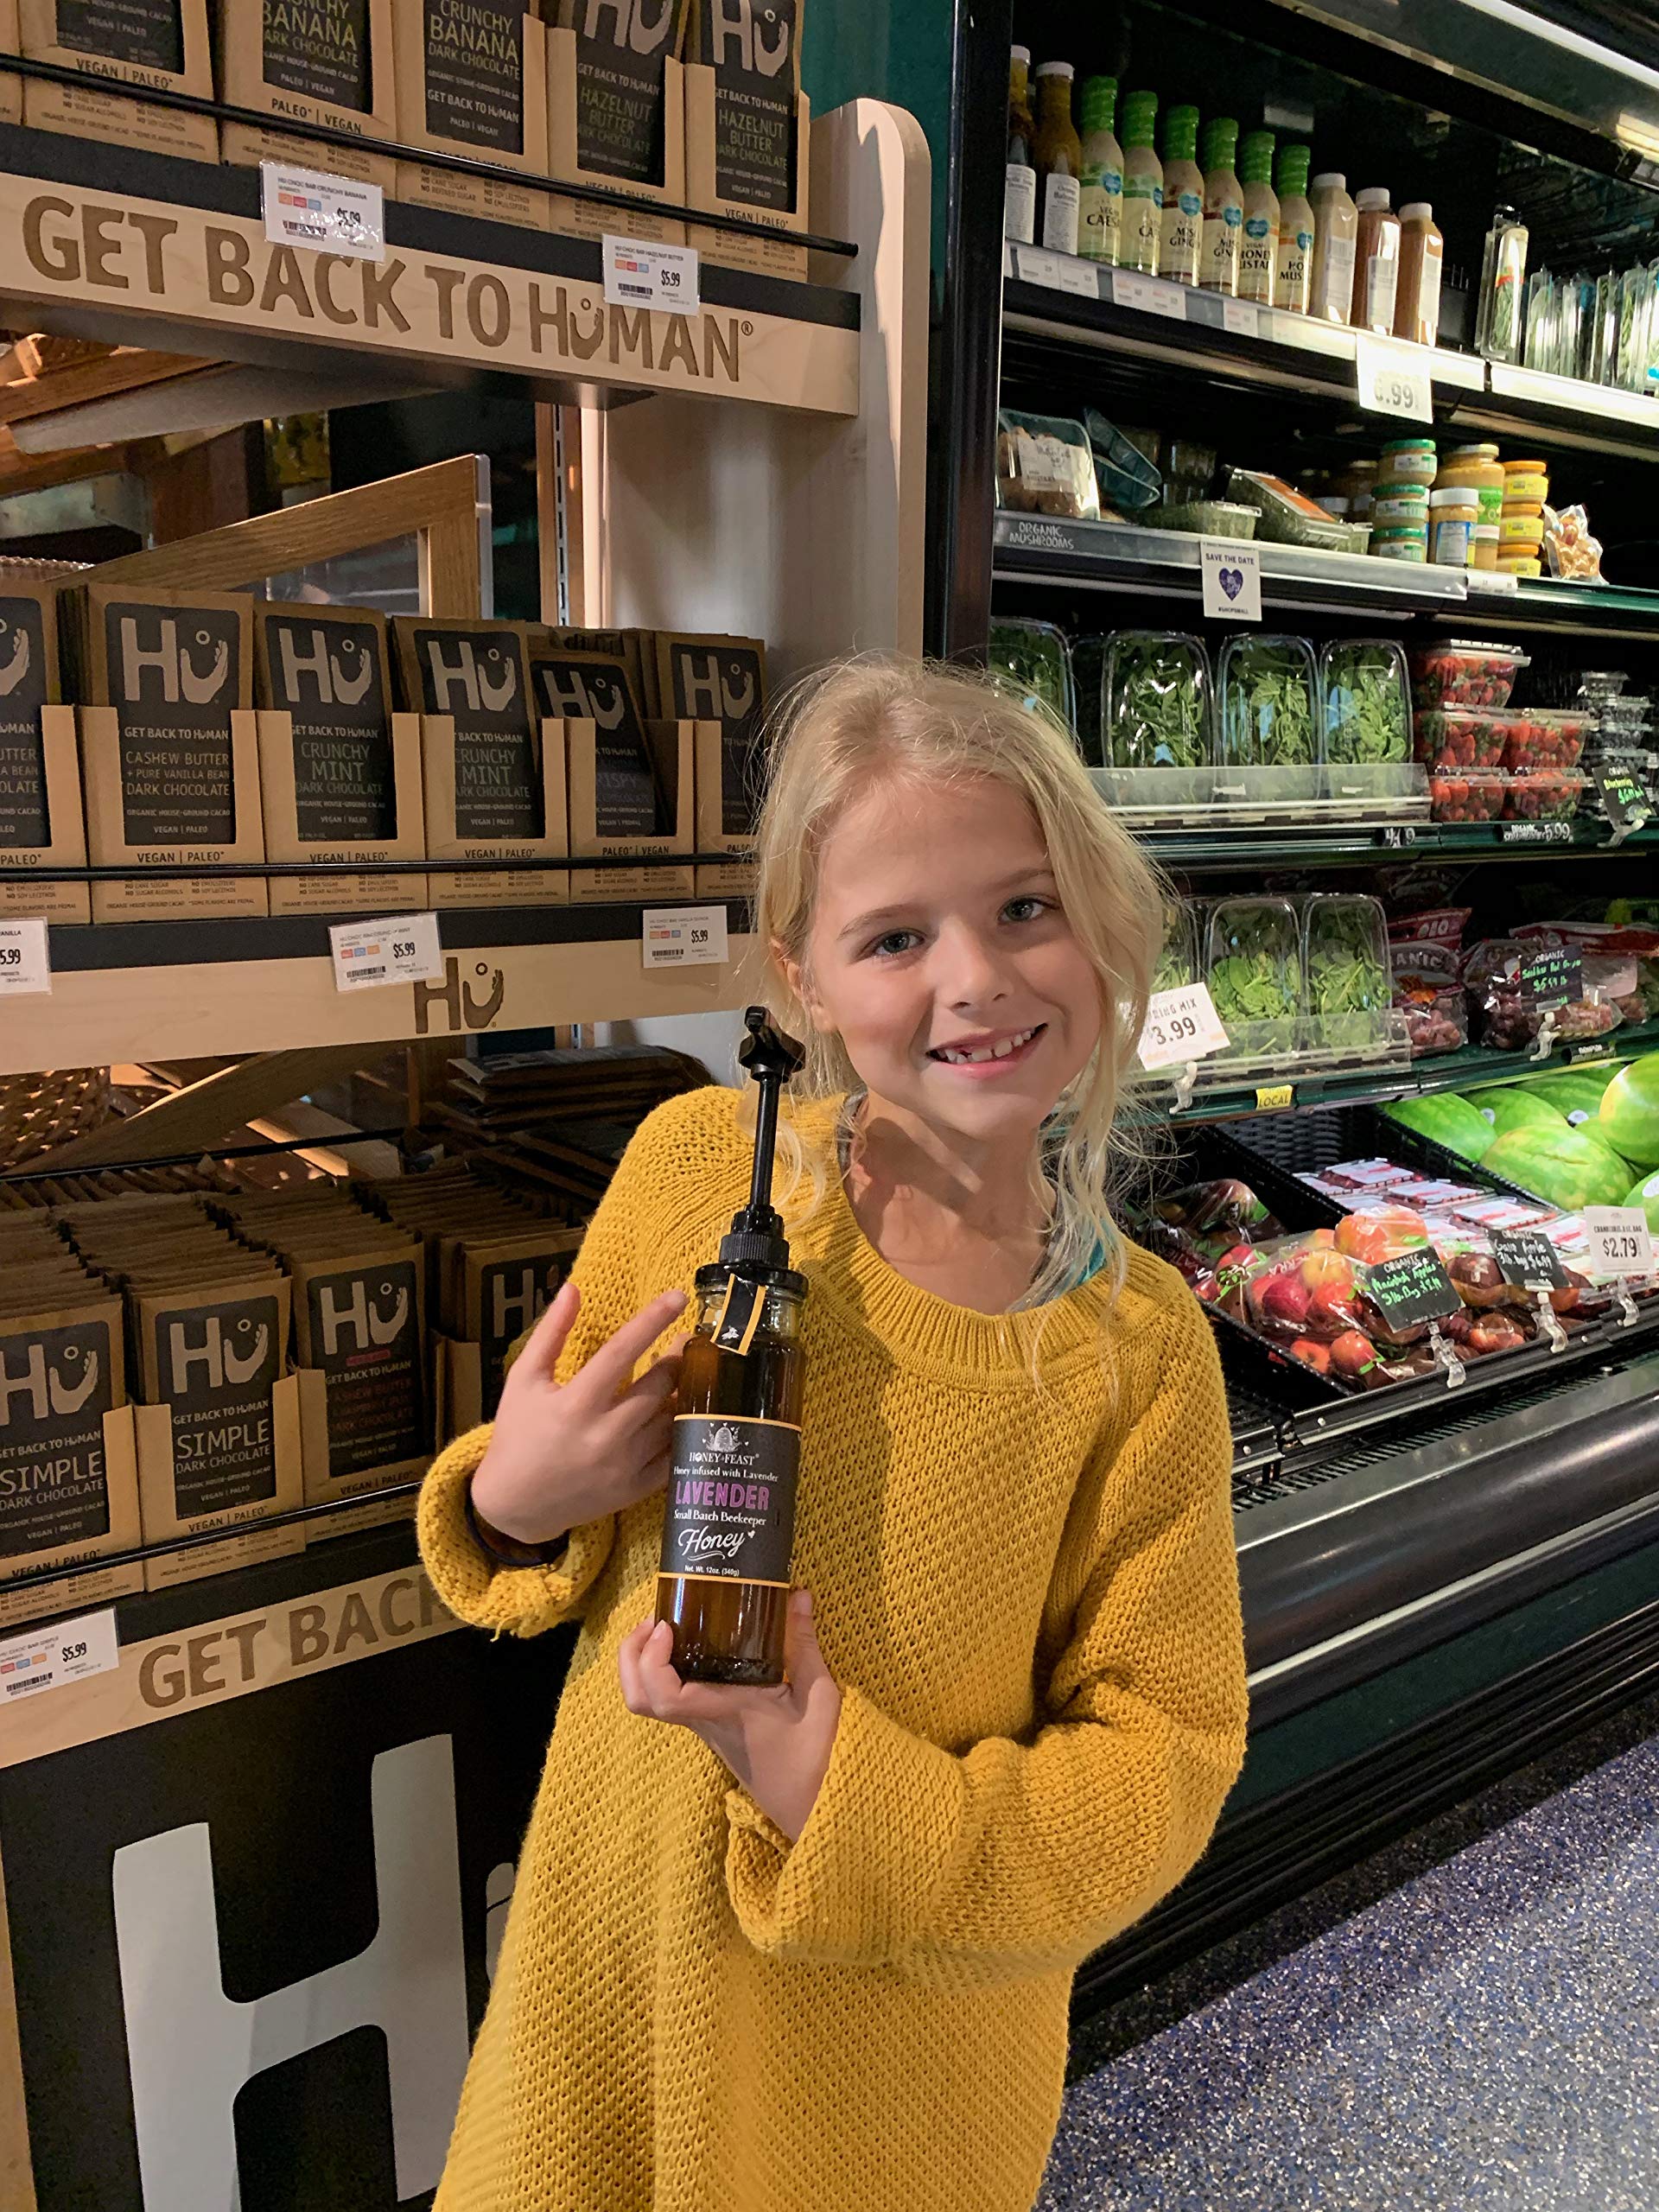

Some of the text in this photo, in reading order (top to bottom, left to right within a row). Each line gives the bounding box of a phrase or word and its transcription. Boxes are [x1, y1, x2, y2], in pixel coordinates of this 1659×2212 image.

[440, 0, 513, 35] CRUNCHY
[431, 13, 519, 66] BANANA
[292, 35, 359, 68] CHOCOLATE
[75, 57, 118, 78] VEGAN
[429, 41, 521, 81] DARK CHOCOLATE
[576, 63, 594, 76] GET
[594, 67, 617, 84] BACK
[619, 74, 630, 86] TO
[427, 89, 446, 104] GET
[448, 94, 474, 111] BACK
[474, 101, 487, 114] TO
[580, 86, 653, 122] HAZELNUT
[728, 90, 750, 105] BACK
[751, 97, 761, 108] TO
[325, 114, 362, 135] VEGAN
[589, 110, 636, 136] BUTTER
[718, 109, 785, 139] HAZELNUT
[729, 130, 772, 153] BUTTER
[739, 147, 788, 171] CHOCOLATE
[725, 207, 753, 223] VEGAN
[22, 195, 178, 295] GET
[205, 226, 411, 334] BACK
[424, 264, 511, 347] TO
[661, 269, 681, 287] $5.99
[1019, 521, 1063, 537] ORGANIC
[1009, 531, 1075, 550] MUSHROOMS
[1205, 553, 1255, 565] SAVE THE DATE
[124, 728, 146, 738] GET
[147, 728, 176, 740] BACK
[178, 729, 192, 740] TO
[308, 726, 334, 736] BACK
[334, 727, 346, 737] TO
[458, 732, 481, 742] BACK
[482, 733, 493, 742] TO
[126, 751, 229, 766] CASHEW BUTTER
[301, 742, 370, 760] CRUNCHY
[12, 766, 38, 776] BEAN
[137, 770, 230, 779] PURE VANILLA BEAN
[312, 761, 365, 782] MINT
[461, 766, 512, 785] MINT
[127, 783, 230, 796] DARK CHOCOLATE
[296, 782, 383, 795] DARK CHOCOLATE
[476, 786, 530, 798] CHOCOLATE
[154, 825, 208, 834] VEGAN PALEO
[137, 852, 175, 863] VEGAN
[309, 853, 346, 864] VEGAN
[465, 849, 496, 859] VEGAN
[641, 845, 670, 855] VEGAN
[691, 929, 709, 944] $5.99
[393, 942, 416, 959] $5.99
[1179, 997, 1198, 1012] MIX
[1258, 1094, 1289, 1108] LOCAL
[1603, 1236, 1637, 1258] $2.79
[1382, 1254, 1420, 1273] ORGANIC
[343, 1369, 368, 1382] BACK
[370, 1367, 381, 1377] TO
[174, 1414, 192, 1426] GET
[194, 1408, 221, 1423] BACK
[222, 1407, 235, 1418] TO
[17, 1441, 47, 1456] BACK
[48, 1439, 63, 1450] TO
[176, 1418, 270, 1459] SIMPLE
[175, 1444, 270, 1474] DARK CHOCOLATE
[0, 1450, 103, 1495] SIMPLE
[692, 1465, 721, 1477] infused
[722, 1469, 741, 1478] with
[743, 1469, 779, 1483] Lavender
[0, 1478, 104, 1512] DARK CHOCOLATE
[200, 1491, 224, 1502] VEGAN
[340, 1480, 372, 1496] VEGAN
[675, 1479, 770, 1511] LAVENDER
[188, 1517, 223, 1533] VEGAN
[674, 1509, 767, 1528] Small Batch Beekeeper
[28, 1529, 53, 1540] VEGAN
[677, 1525, 746, 1558] Honey
[61, 1642, 87, 1662] $5.99
[137, 1619, 267, 1709] GET
